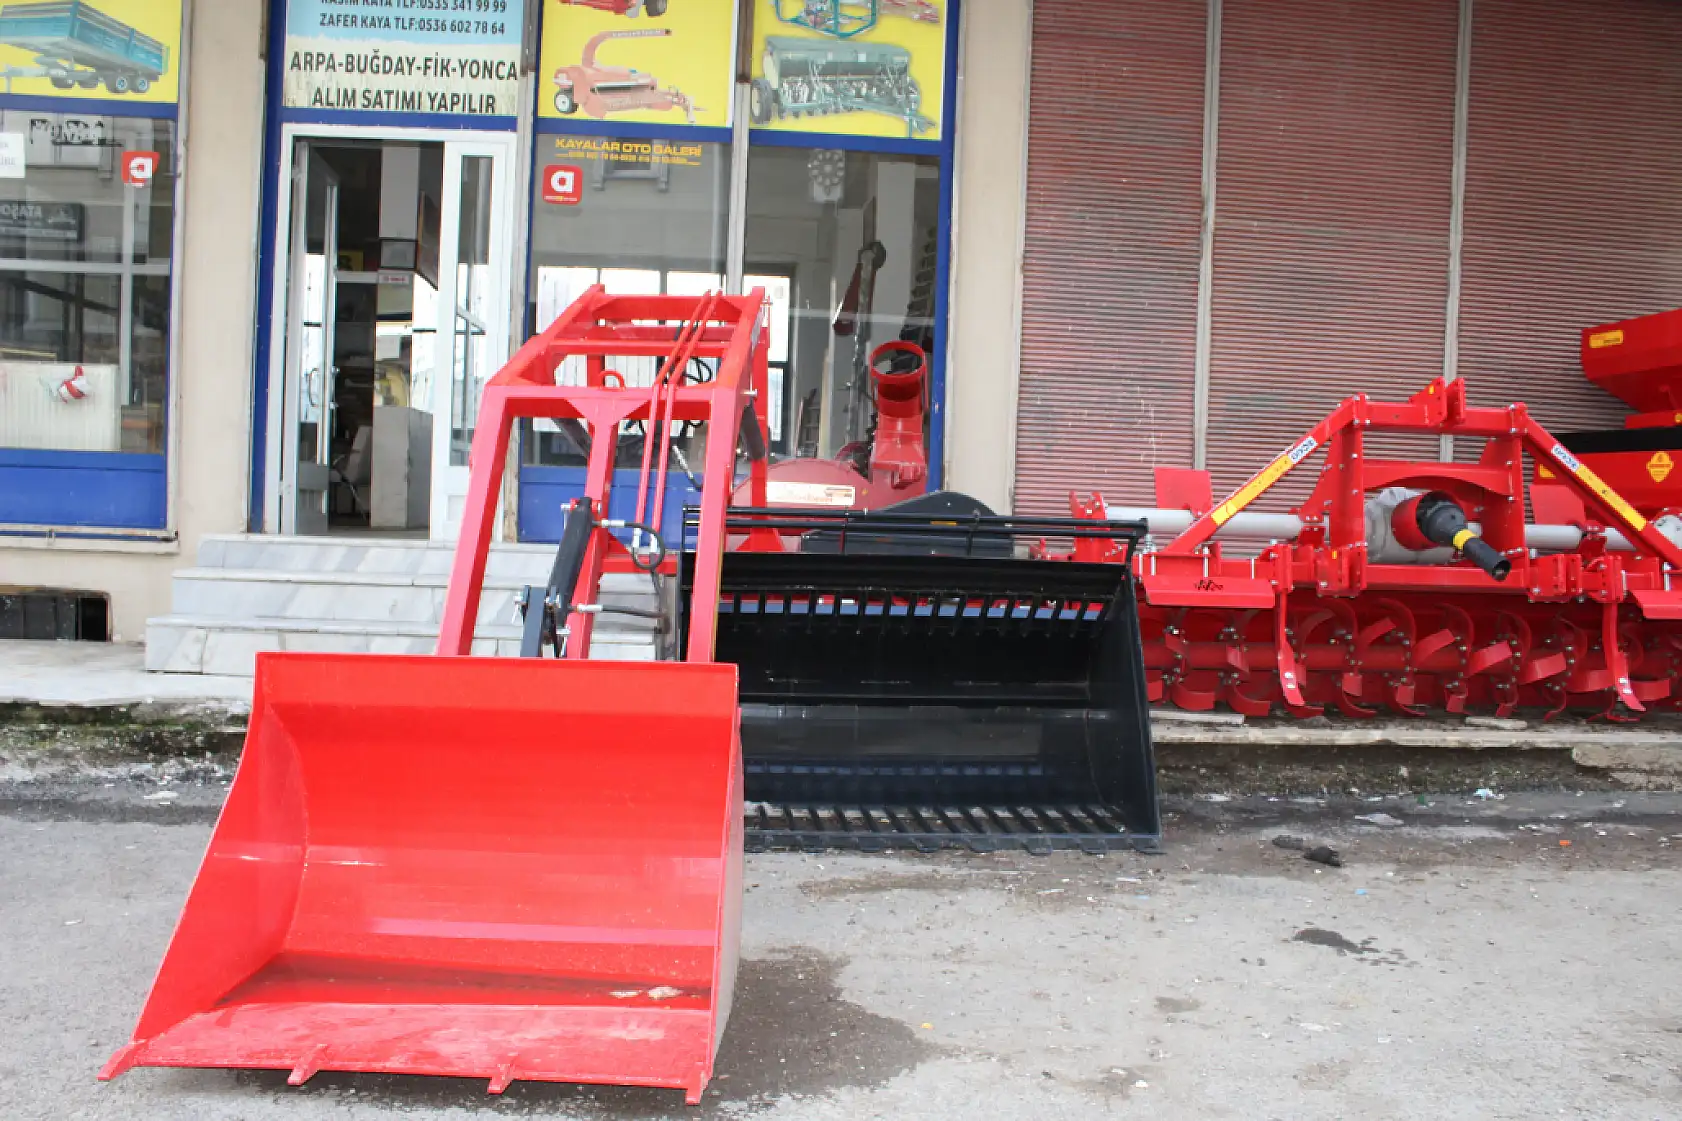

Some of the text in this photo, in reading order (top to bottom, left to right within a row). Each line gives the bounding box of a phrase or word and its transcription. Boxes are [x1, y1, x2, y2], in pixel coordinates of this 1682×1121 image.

[475, 0, 490, 12] 99
[492, 0, 507, 13] 99
[320, 12, 358, 28] ZAFER
[361, 15, 392, 29] KAYA
[450, 19, 472, 34] 602
[474, 20, 488, 34] 78
[491, 22, 505, 35] 64
[312, 86, 496, 114] ALIM SATIMI YAPILIR
[555, 138, 620, 152] KAYALAR
[622, 142, 652, 154] OTO
